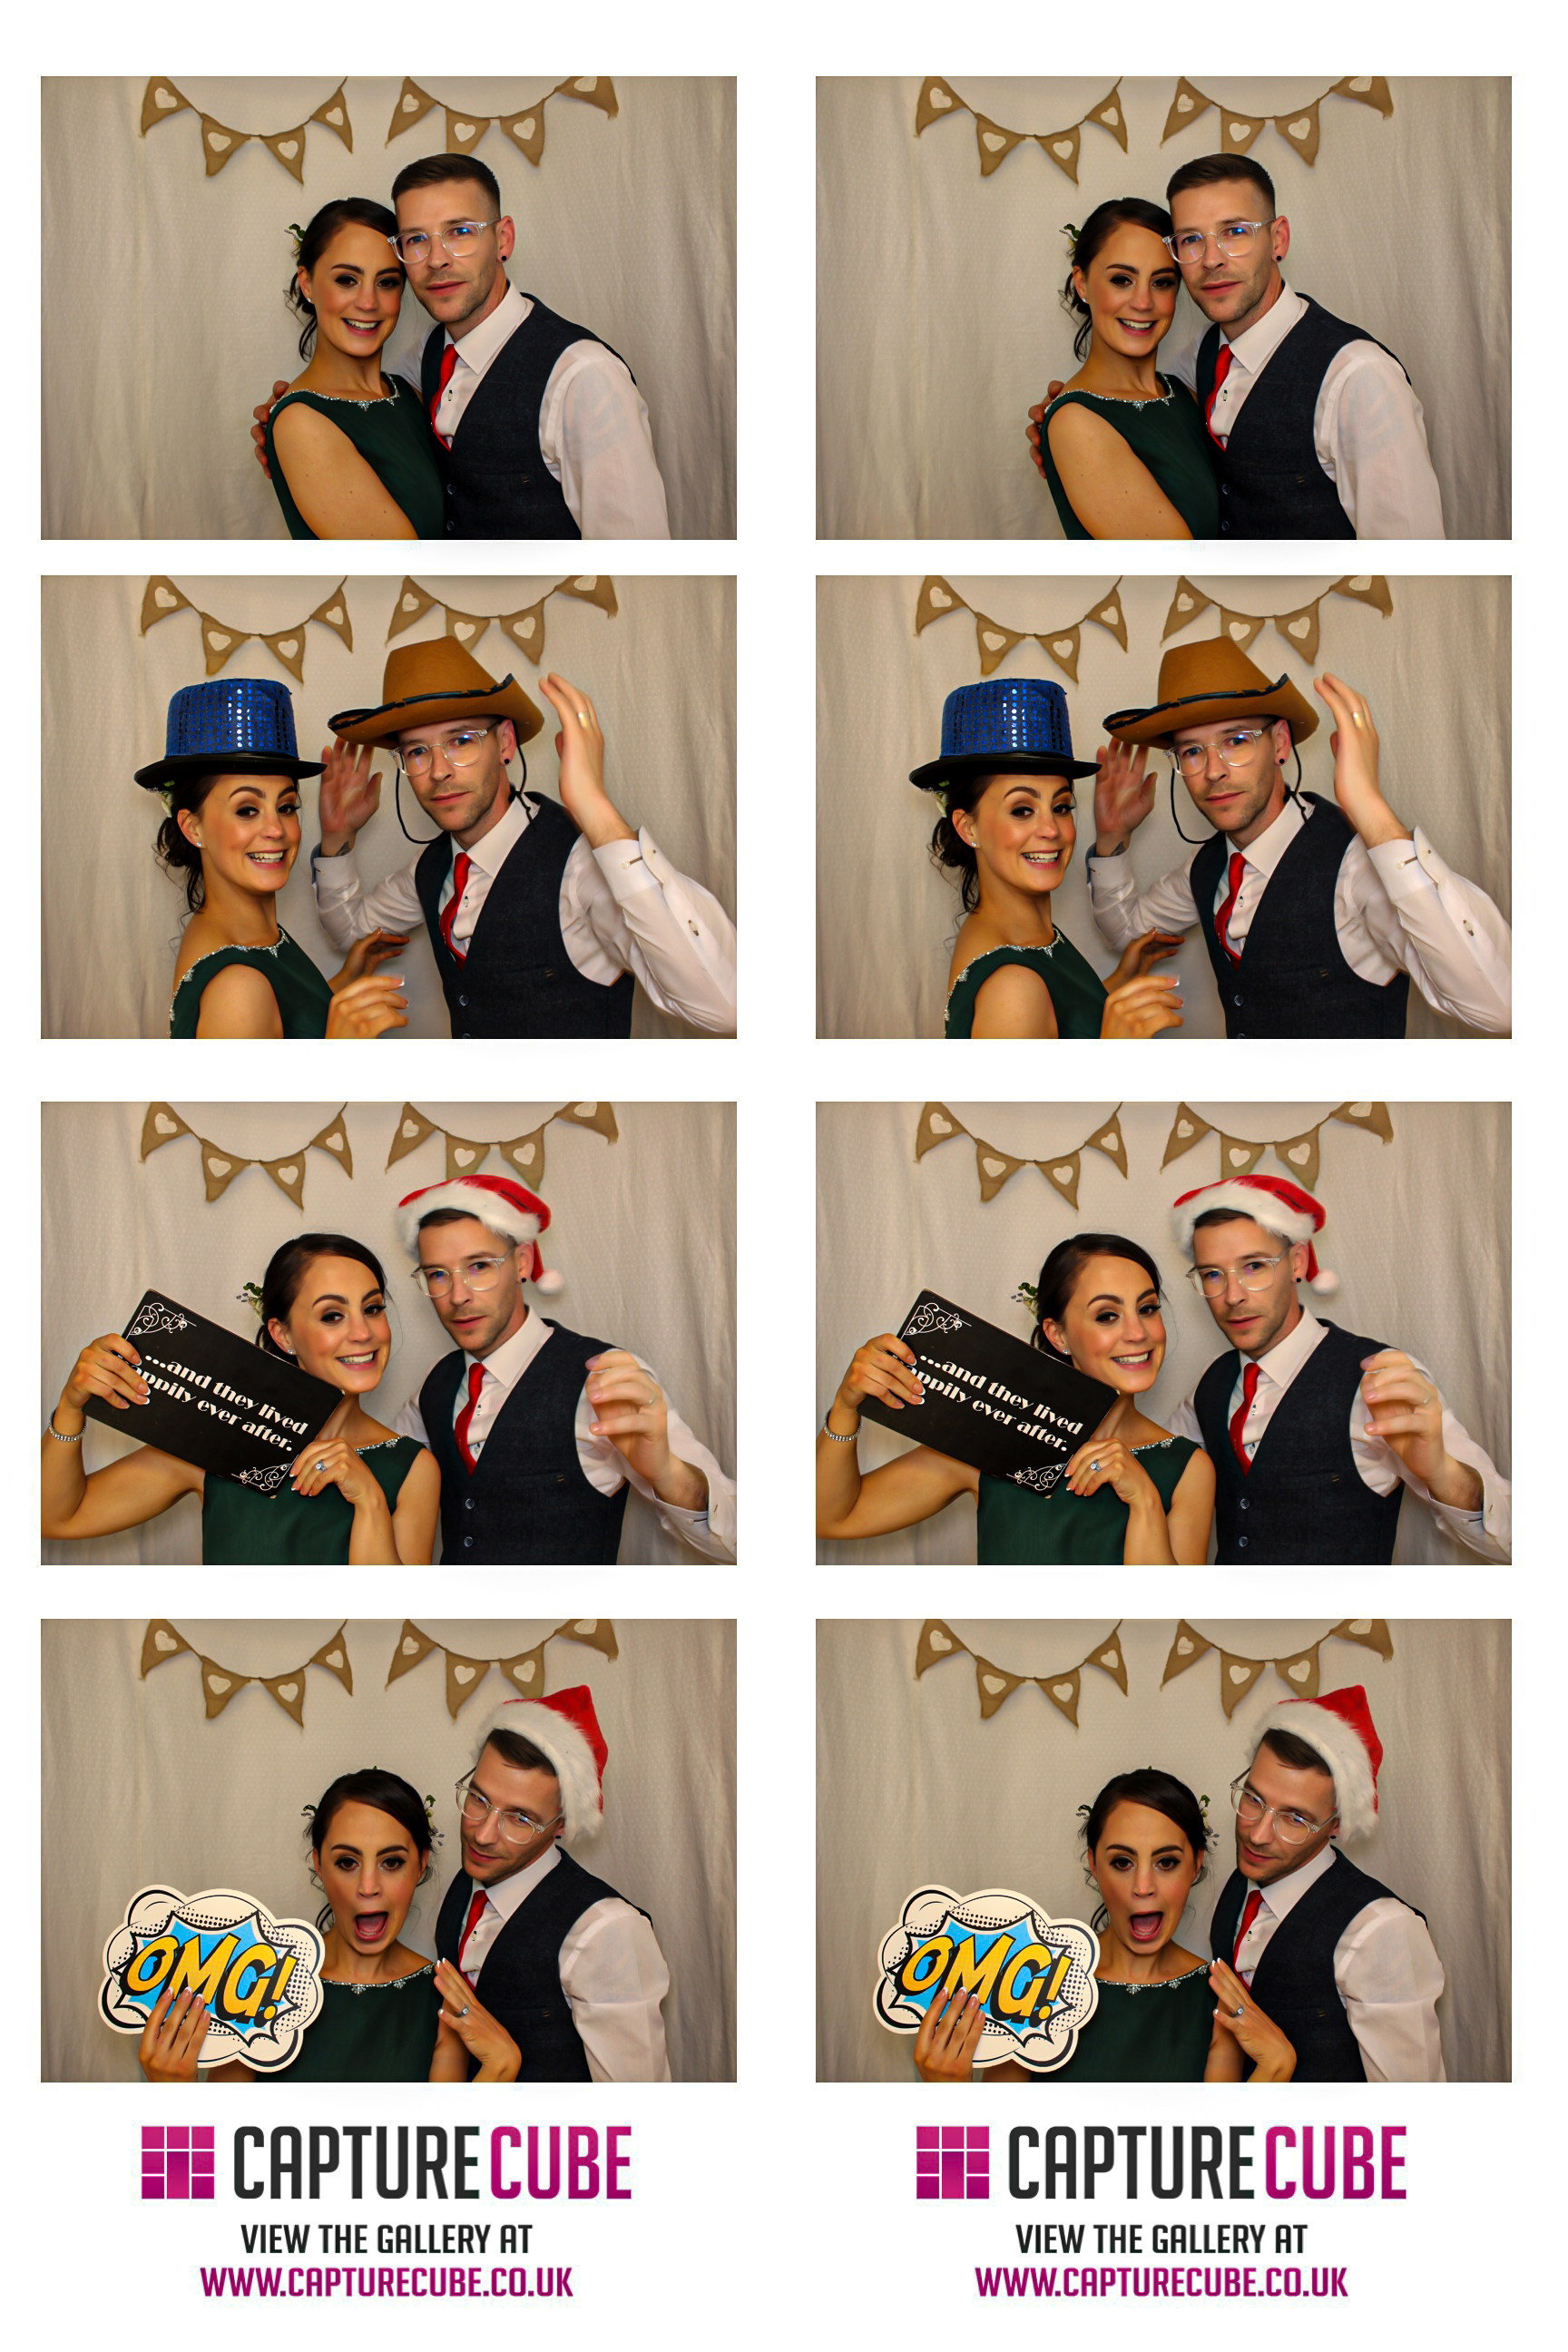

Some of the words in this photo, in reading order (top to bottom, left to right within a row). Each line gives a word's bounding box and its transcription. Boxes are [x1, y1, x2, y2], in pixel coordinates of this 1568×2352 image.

[118, 1355, 197, 1403] ppily
[197, 1400, 242, 1426] ever
[241, 1421, 292, 1452] after.
[212, 1382, 260, 1410] they
[258, 1403, 309, 1436] lived
[893, 1355, 972, 1403] ppily
[972, 1400, 1017, 1426] ever
[1016, 1421, 1067, 1452] after.
[987, 1382, 1034, 1410] they
[1033, 1403, 1083, 1436] lived
[121, 1933, 299, 2025] OMG!
[896, 1933, 1074, 2025] OMG!
